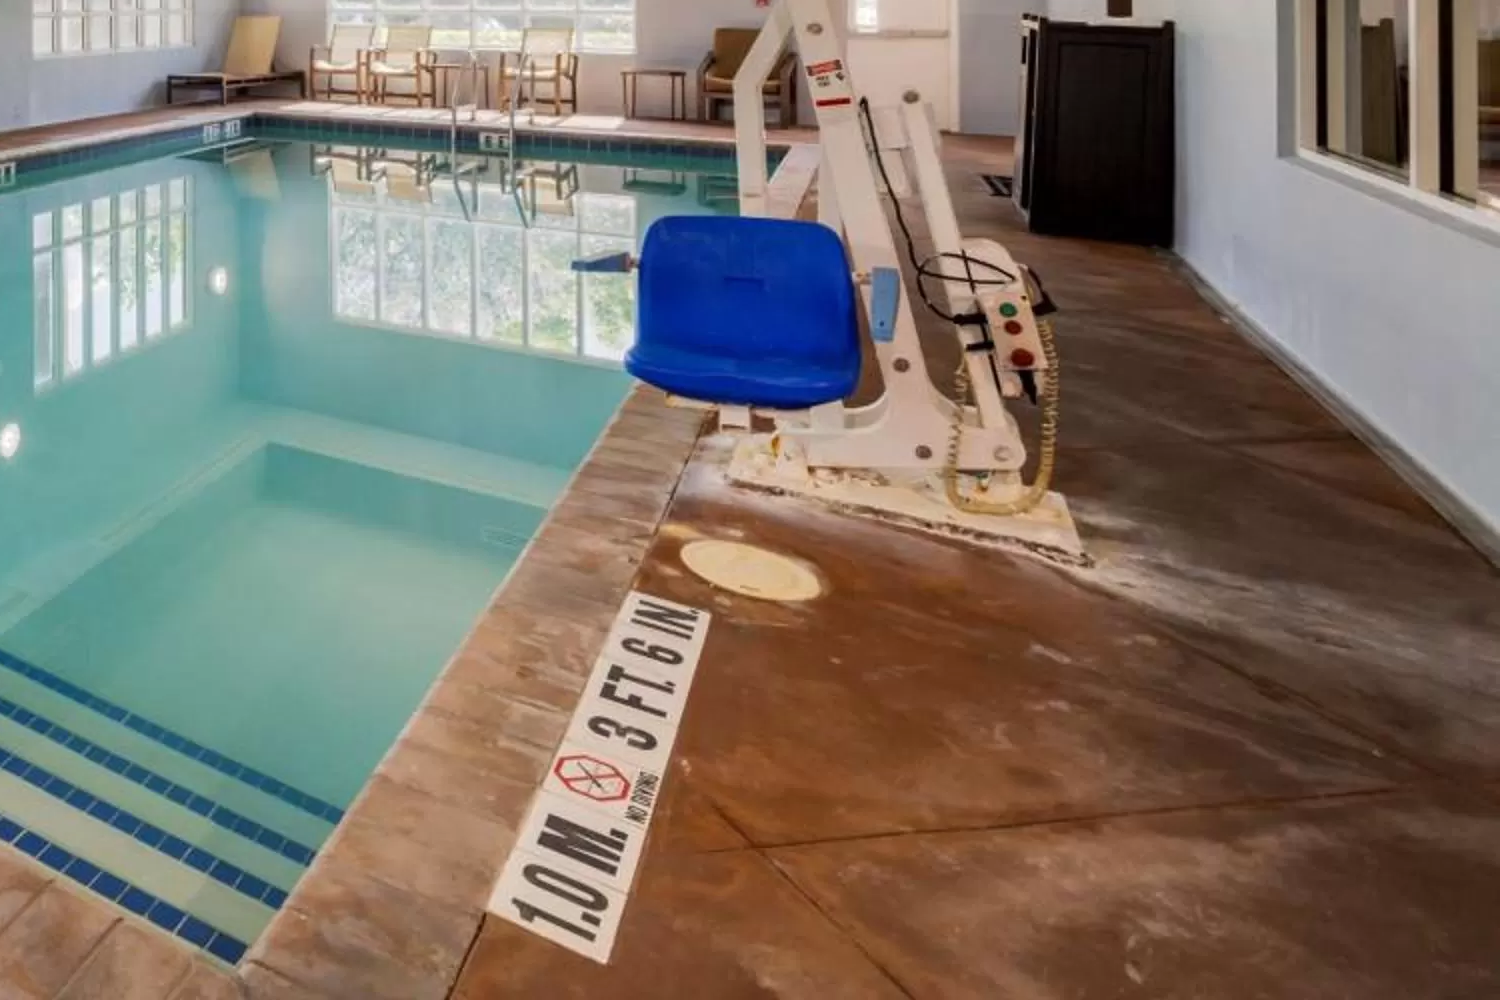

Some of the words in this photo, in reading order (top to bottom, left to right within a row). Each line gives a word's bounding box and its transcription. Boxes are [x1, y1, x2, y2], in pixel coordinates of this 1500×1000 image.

[620, 637, 684, 666] 6
[587, 715, 657, 751] 3
[624, 805, 648, 824] NO
[537, 813, 629, 877] M.
[511, 862, 611, 942] 1.0
